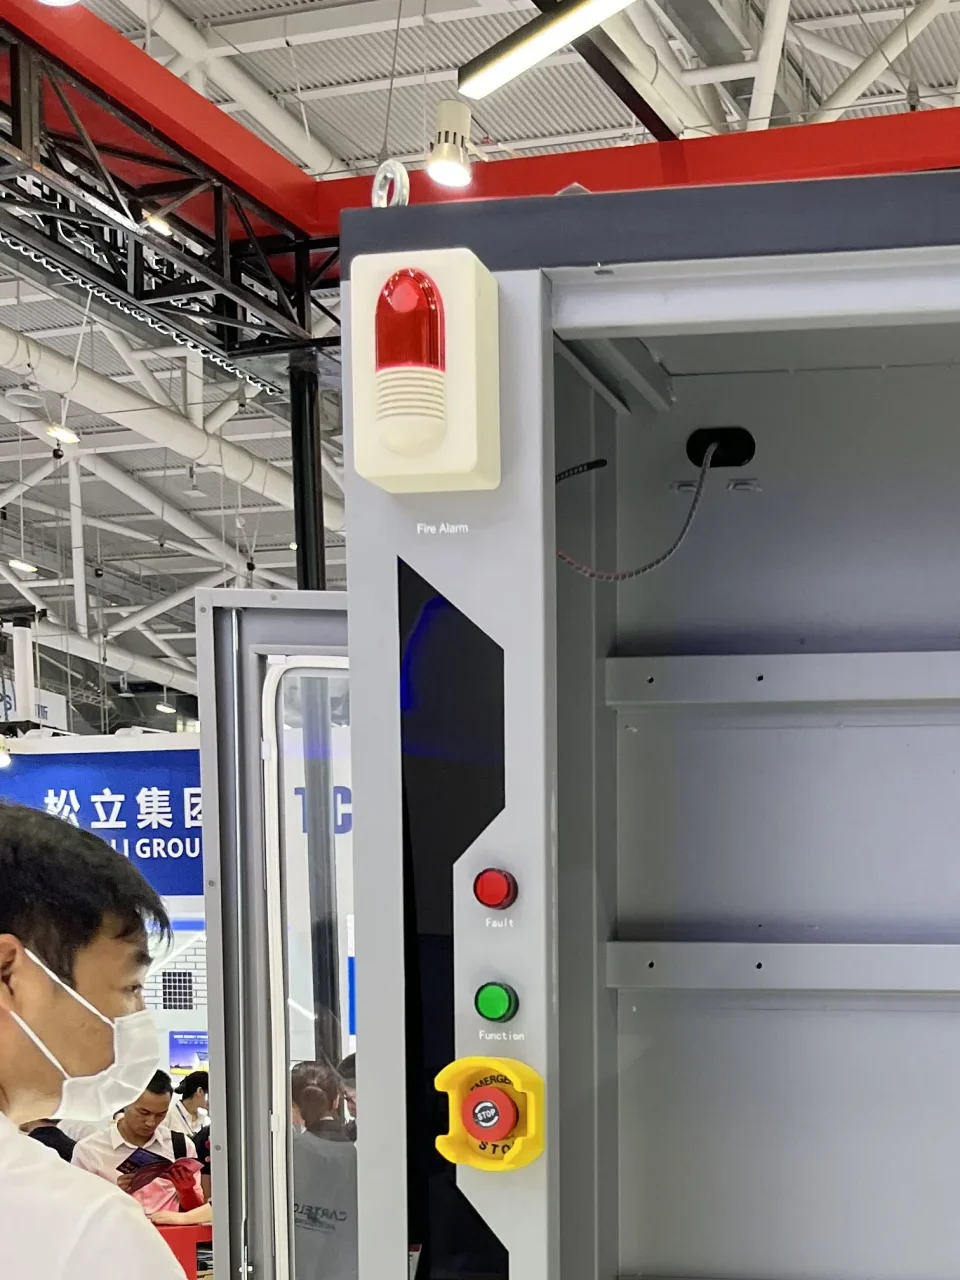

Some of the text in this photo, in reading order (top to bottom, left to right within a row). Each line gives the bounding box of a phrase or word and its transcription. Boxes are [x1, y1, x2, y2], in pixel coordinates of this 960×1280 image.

[417, 522, 469, 535] Fire Alarm
[485, 917, 514, 928] Fault
[478, 1029, 525, 1041] Function
[476, 1107, 497, 1121] STOP
[478, 1140, 516, 1156] STO
